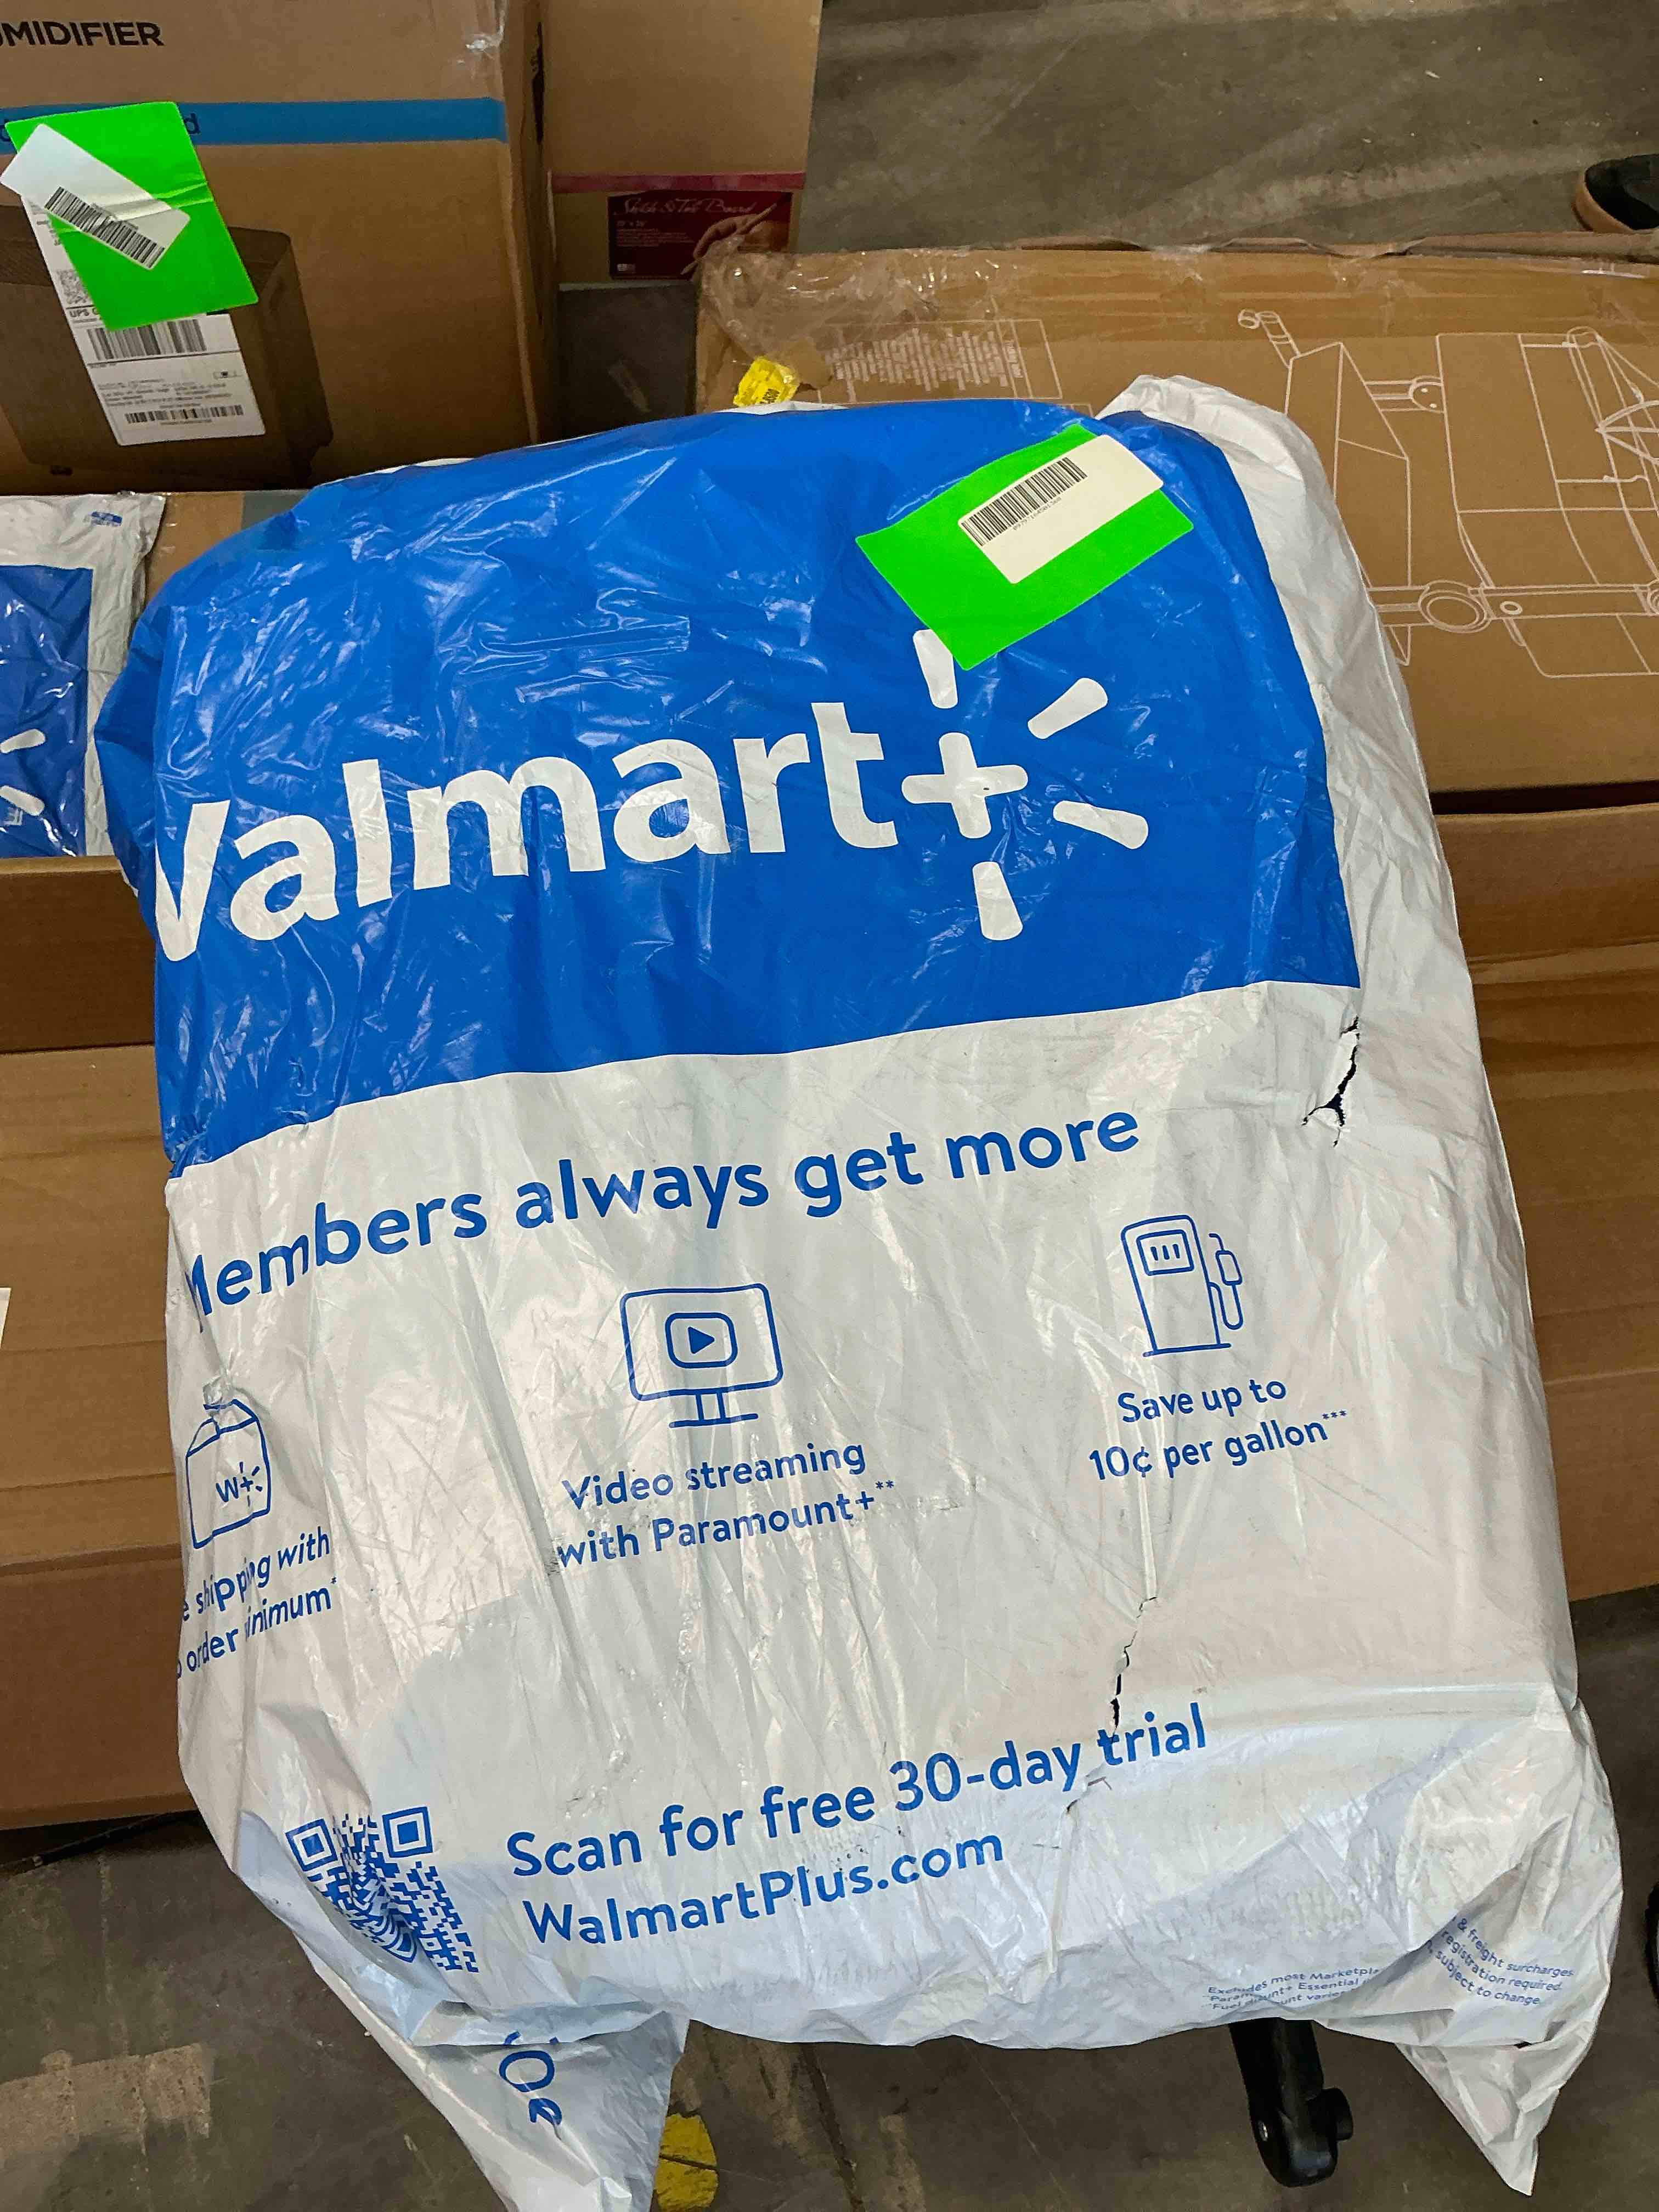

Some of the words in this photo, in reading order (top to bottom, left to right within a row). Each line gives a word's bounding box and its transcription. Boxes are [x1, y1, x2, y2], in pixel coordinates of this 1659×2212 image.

[0, 21, 164, 46] MIDIFIER
[515, 1159, 770, 1229] always
[794, 1132, 925, 1218] get
[945, 1111, 1139, 1179] more
[1118, 1392, 1194, 1423] Save
[1202, 1386, 1242, 1417] up
[1249, 1379, 1286, 1403] to
[561, 1470, 674, 1510] Video
[685, 1443, 867, 1475] streaming
[1089, 1446, 1153, 1480] 10¢
[1164, 1440, 1212, 1478] per
[277, 1526, 330, 1571] with
[557, 1524, 640, 1568] with
[187, 1628, 239, 1672] order
[245, 1576, 337, 1639] inimum
[507, 1830, 642, 1877] Scan
[658, 1804, 744, 1857] for
[759, 1785, 876, 1839] free
[889, 1740, 1082, 1813] 30-day
[1097, 1702, 1207, 1767] trial
[522, 1833, 1005, 1945] WalmartPlus.com
[1441, 1930, 1506, 1985] registration
[1457, 1917, 1468, 1933] &
[1467, 1928, 1505, 1968] freight
[1271, 1973, 1307, 1984] most
[1298, 1978, 1359, 1990] Essential
[1435, 1950, 1475, 1992] subject
[1476, 1985, 1492, 1998] to
